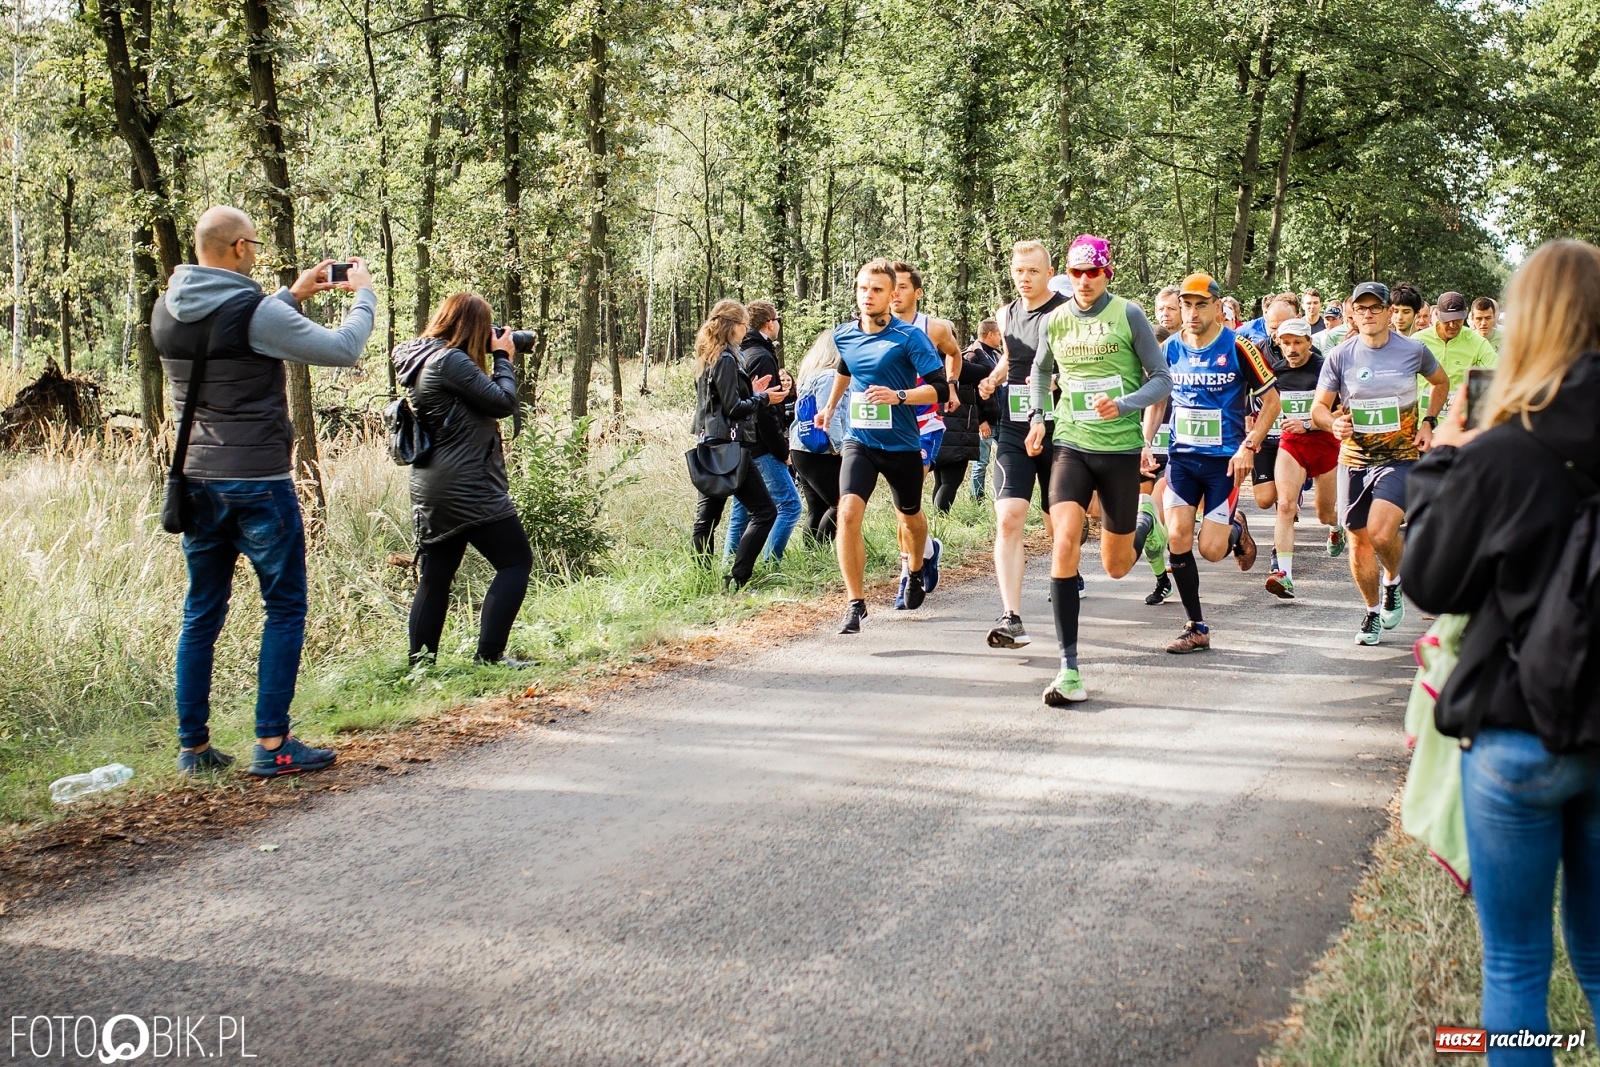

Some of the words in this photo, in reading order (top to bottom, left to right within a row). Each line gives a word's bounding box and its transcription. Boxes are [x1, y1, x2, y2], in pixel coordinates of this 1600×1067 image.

[858, 404, 878, 419] 63
[1290, 401, 1306, 412] 37
[1364, 410, 1384, 424] 71
[1184, 420, 1208, 435] 171
